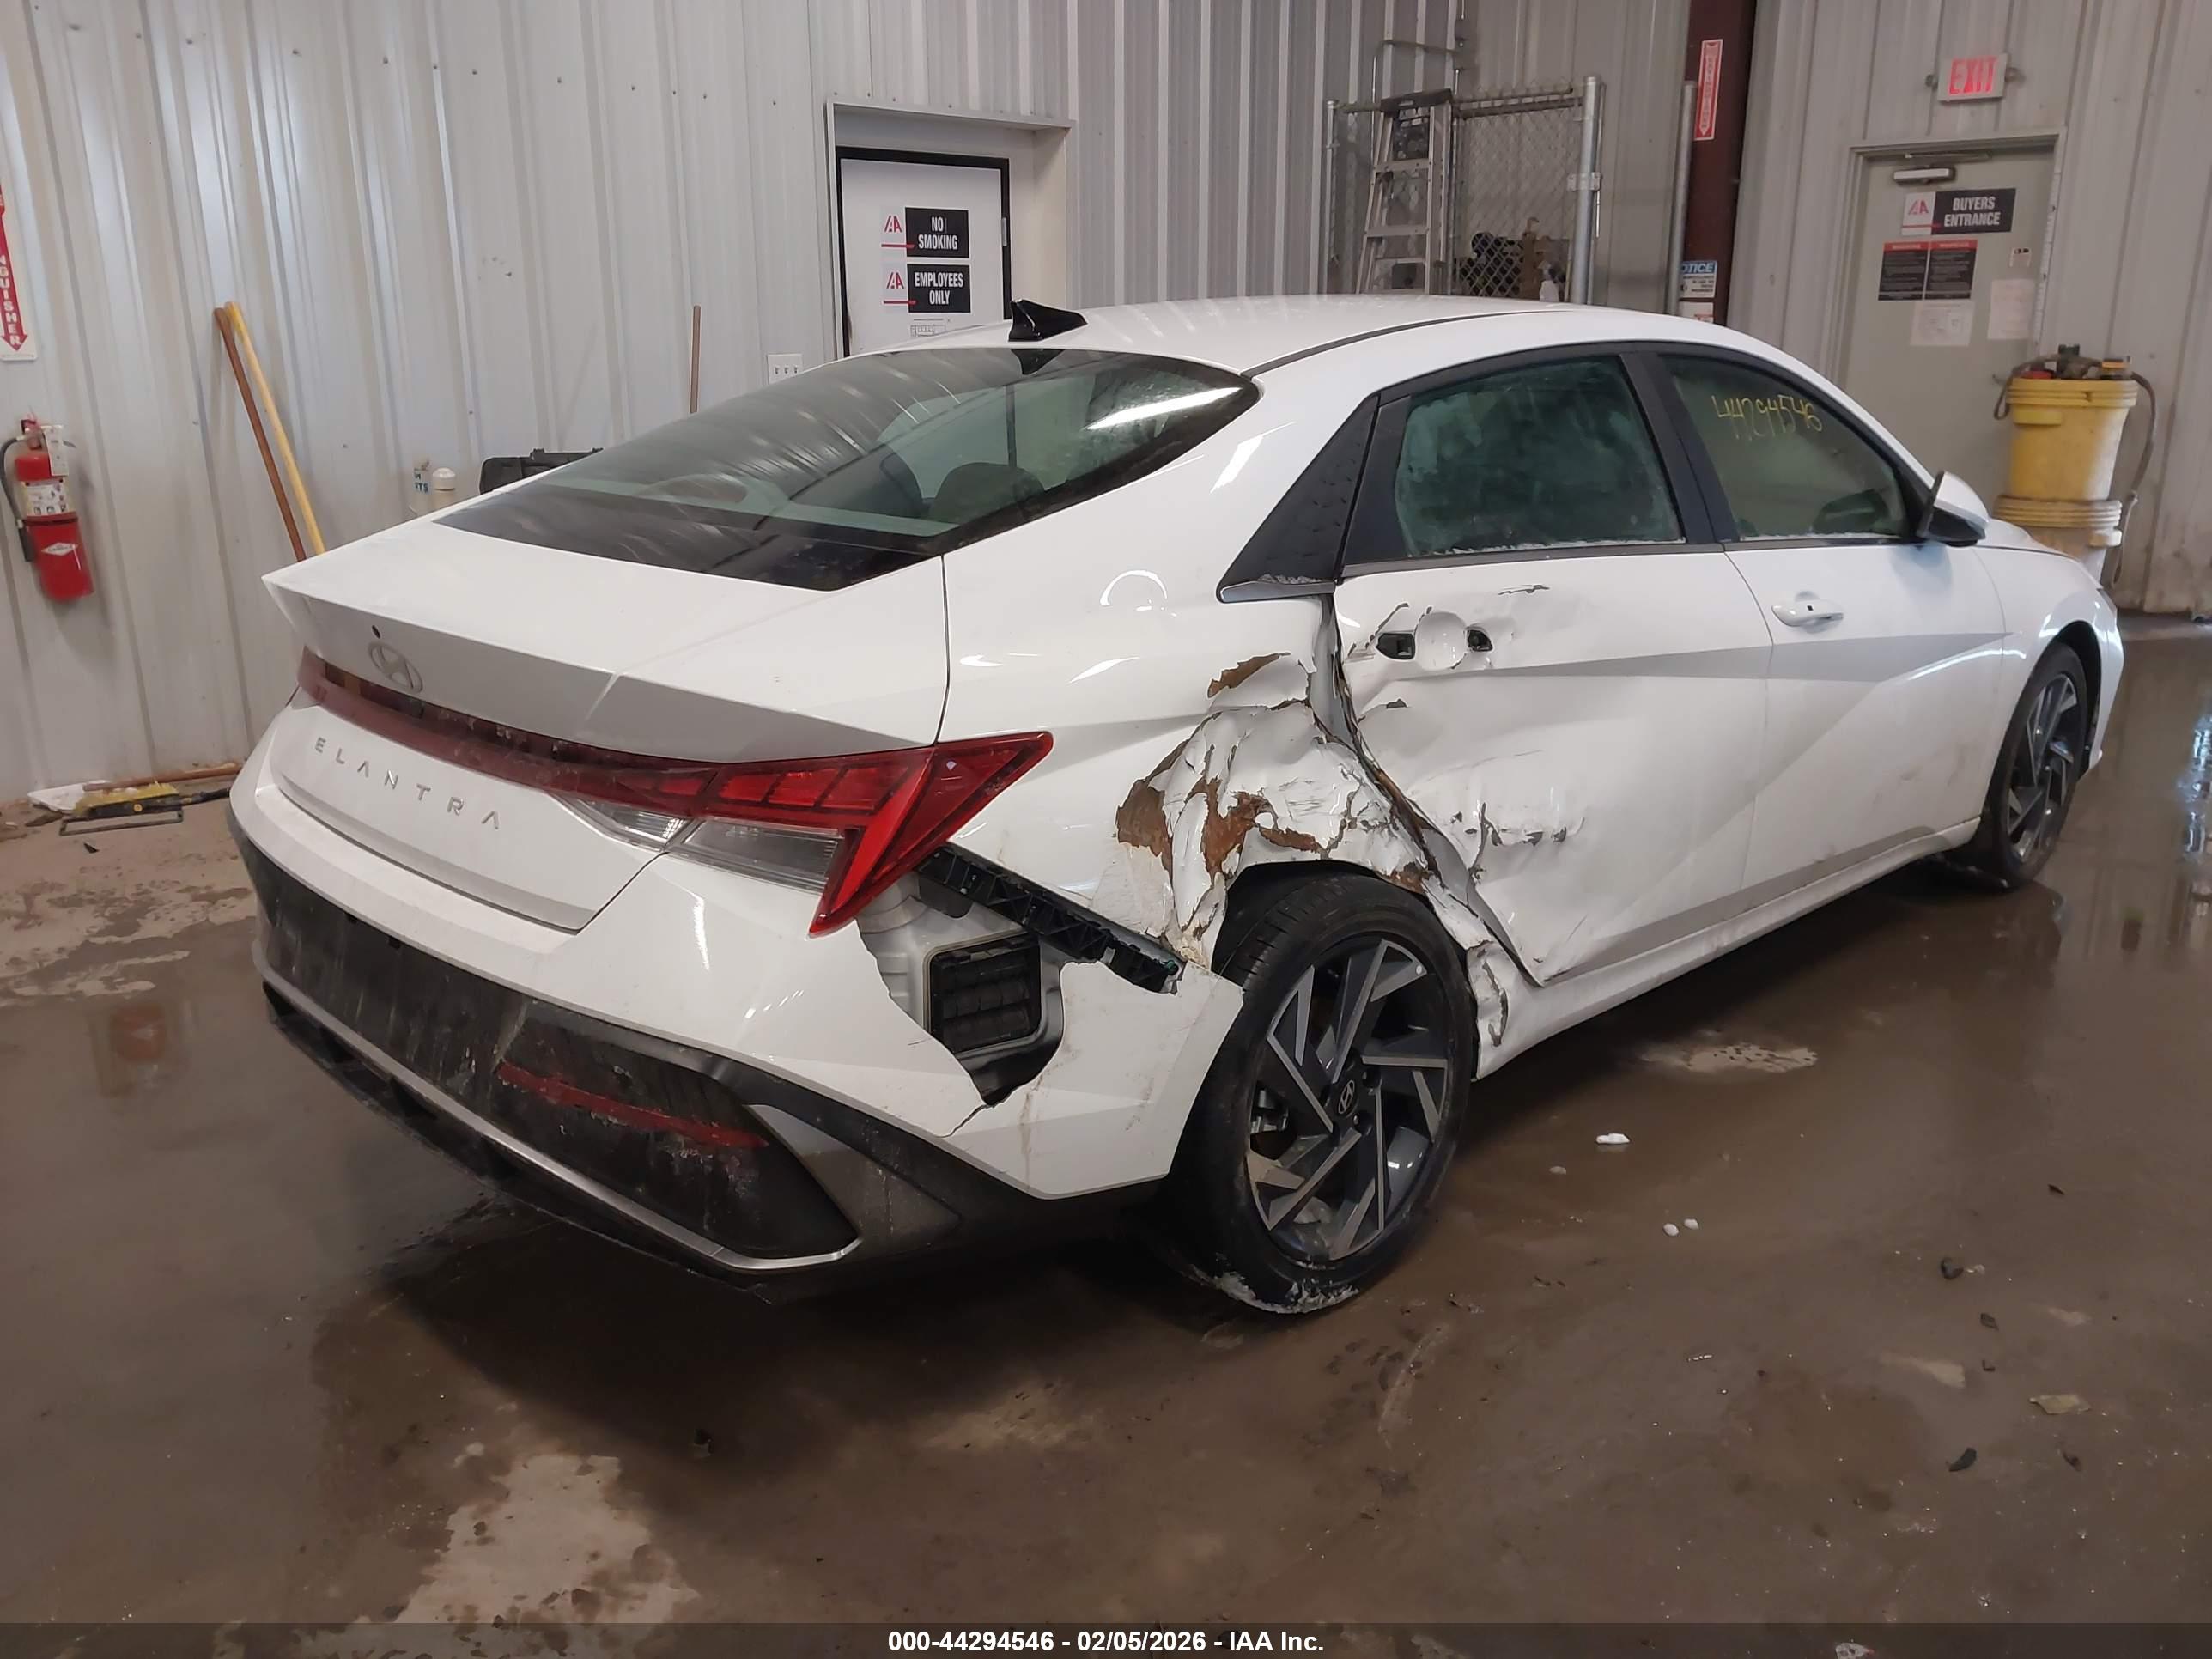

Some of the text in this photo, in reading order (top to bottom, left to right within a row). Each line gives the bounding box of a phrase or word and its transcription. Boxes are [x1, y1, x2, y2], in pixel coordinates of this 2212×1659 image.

[1949, 57, 1997, 95] EXIT
[1952, 197, 1996, 211] BUYERS
[931, 216, 945, 232] NO
[1943, 211, 2001, 228] ENTRANCE
[918, 234, 958, 250] SMOKING
[915, 272, 963, 288] EMPLOYEES
[928, 290, 951, 306] ONLY
[314, 737, 501, 830] ELANTRA
